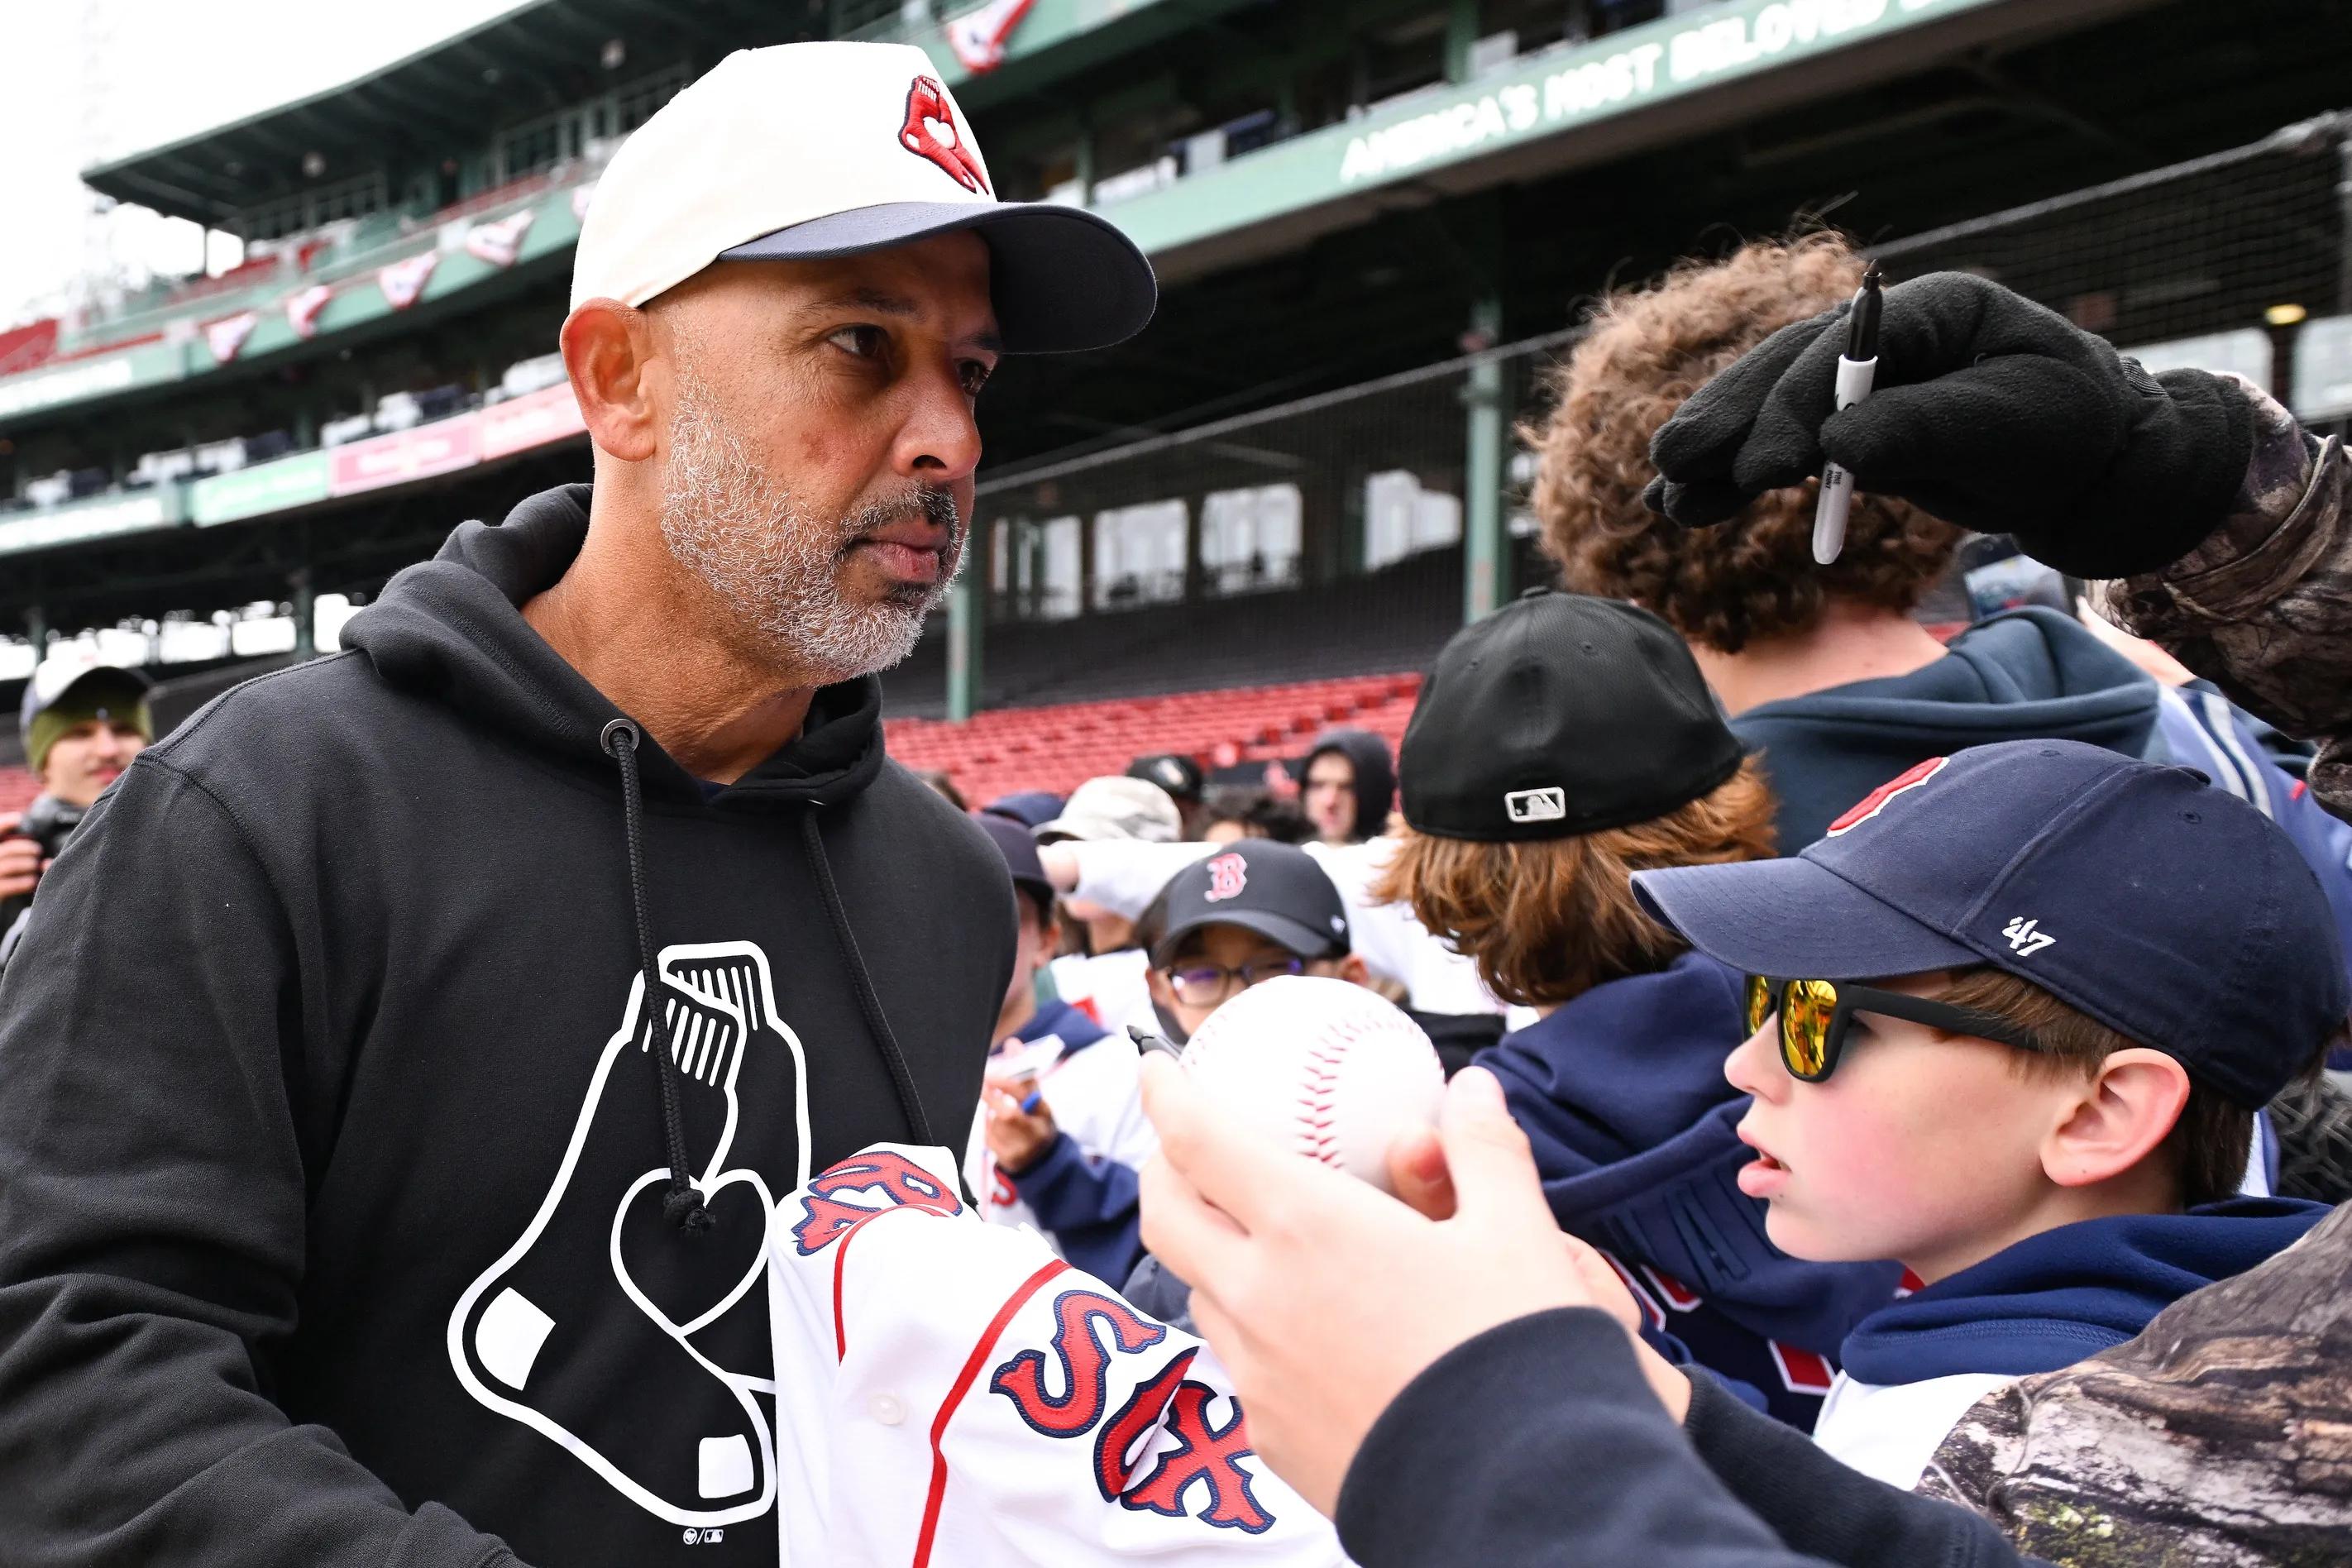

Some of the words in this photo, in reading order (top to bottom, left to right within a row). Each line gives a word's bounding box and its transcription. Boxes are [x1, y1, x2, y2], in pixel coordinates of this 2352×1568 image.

[1339, 84, 1539, 184] AMERICA'S
[1544, 44, 1663, 121] MOST
[1825, 469, 1833, 490] POINT
[1204, 852, 1248, 903] B
